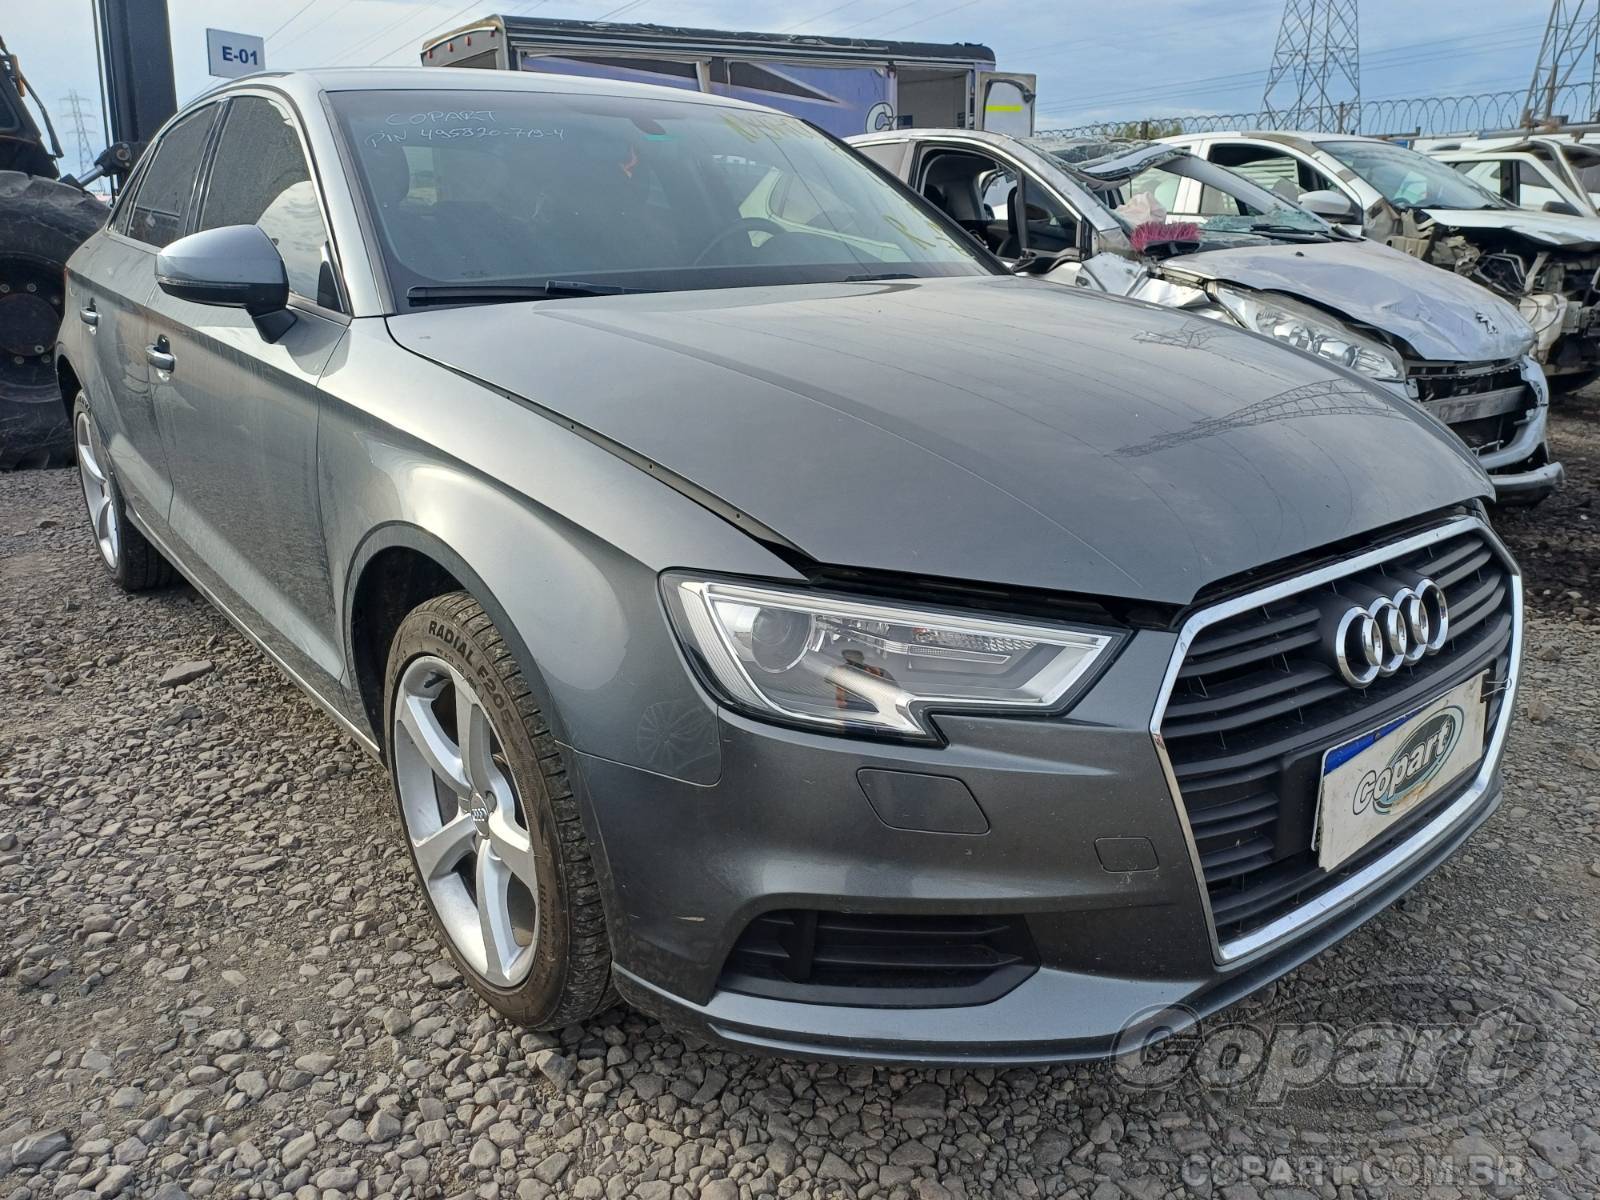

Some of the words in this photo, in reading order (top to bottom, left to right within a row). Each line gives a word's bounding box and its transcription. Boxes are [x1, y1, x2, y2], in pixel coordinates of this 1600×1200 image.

[222, 45, 258, 66] E-01
[385, 110, 497, 126] COPART
[365, 128, 408, 148] PIN
[428, 620, 474, 667] RADIAL
[1352, 719, 1453, 816] Copart
